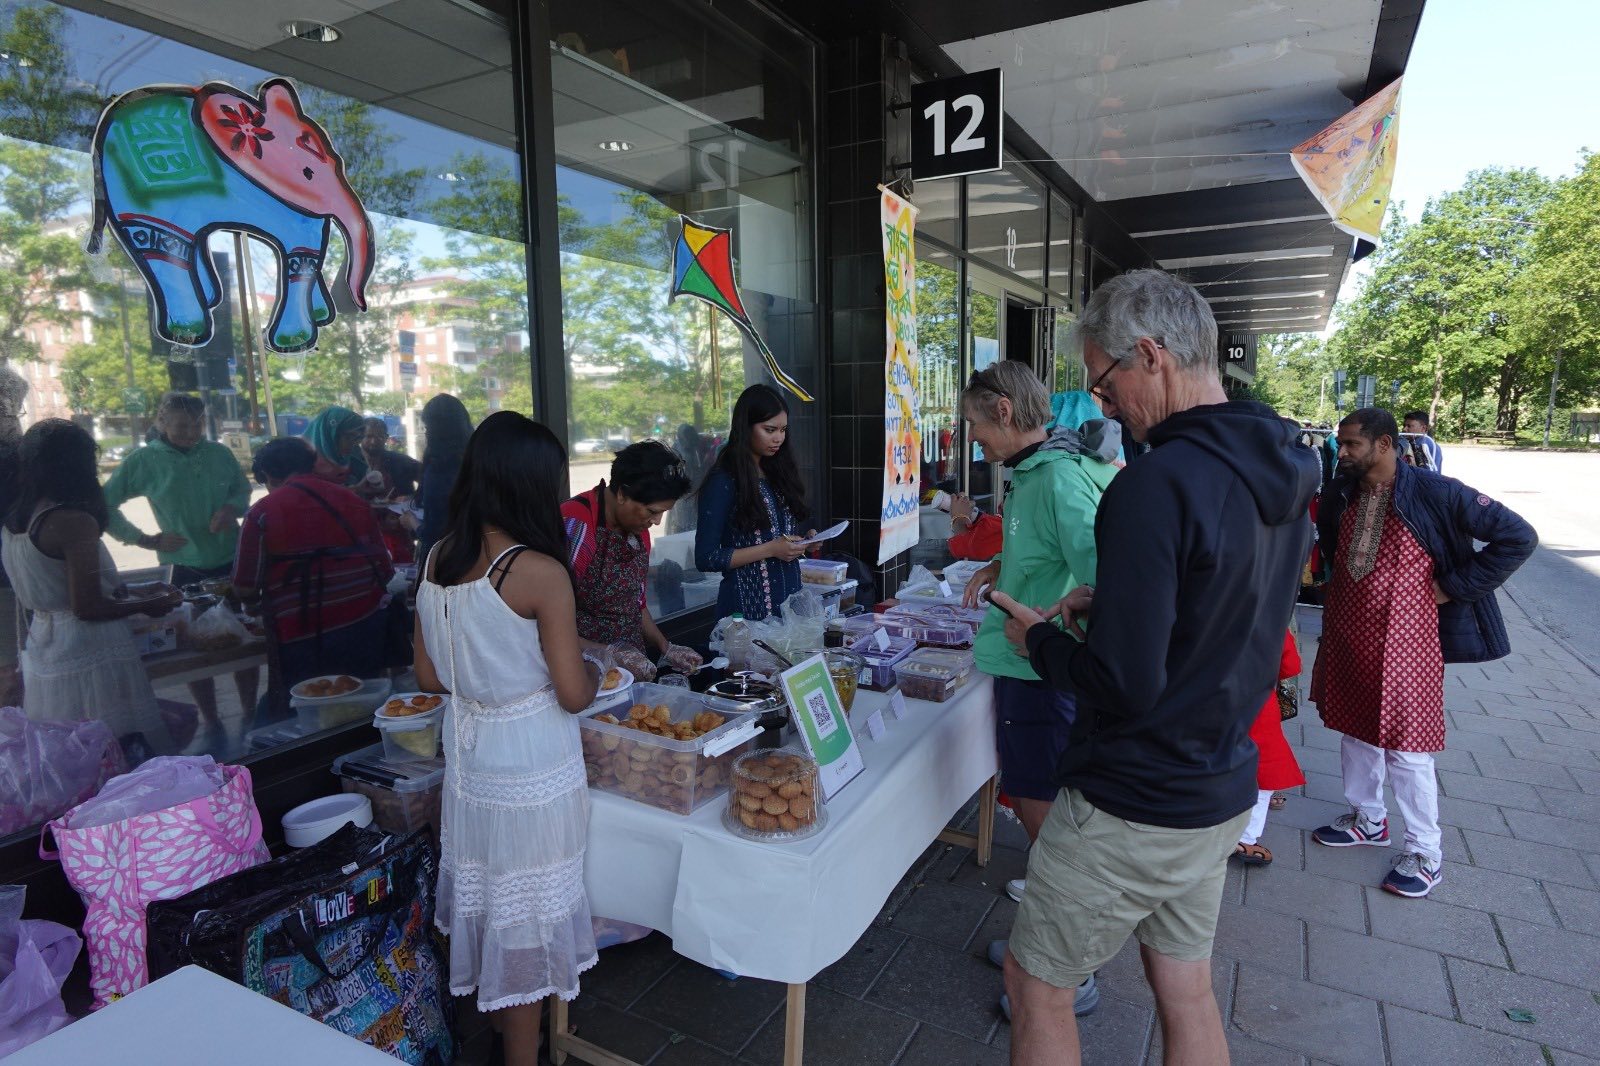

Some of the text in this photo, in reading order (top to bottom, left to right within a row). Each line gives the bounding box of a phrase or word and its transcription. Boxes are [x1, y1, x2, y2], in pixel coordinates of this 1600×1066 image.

[923, 94, 985, 156] 12
[1006, 226, 1017, 269] 12
[1228, 347, 1244, 359] 10
[894, 445, 912, 465] 1432
[315, 891, 356, 927] LOVE
